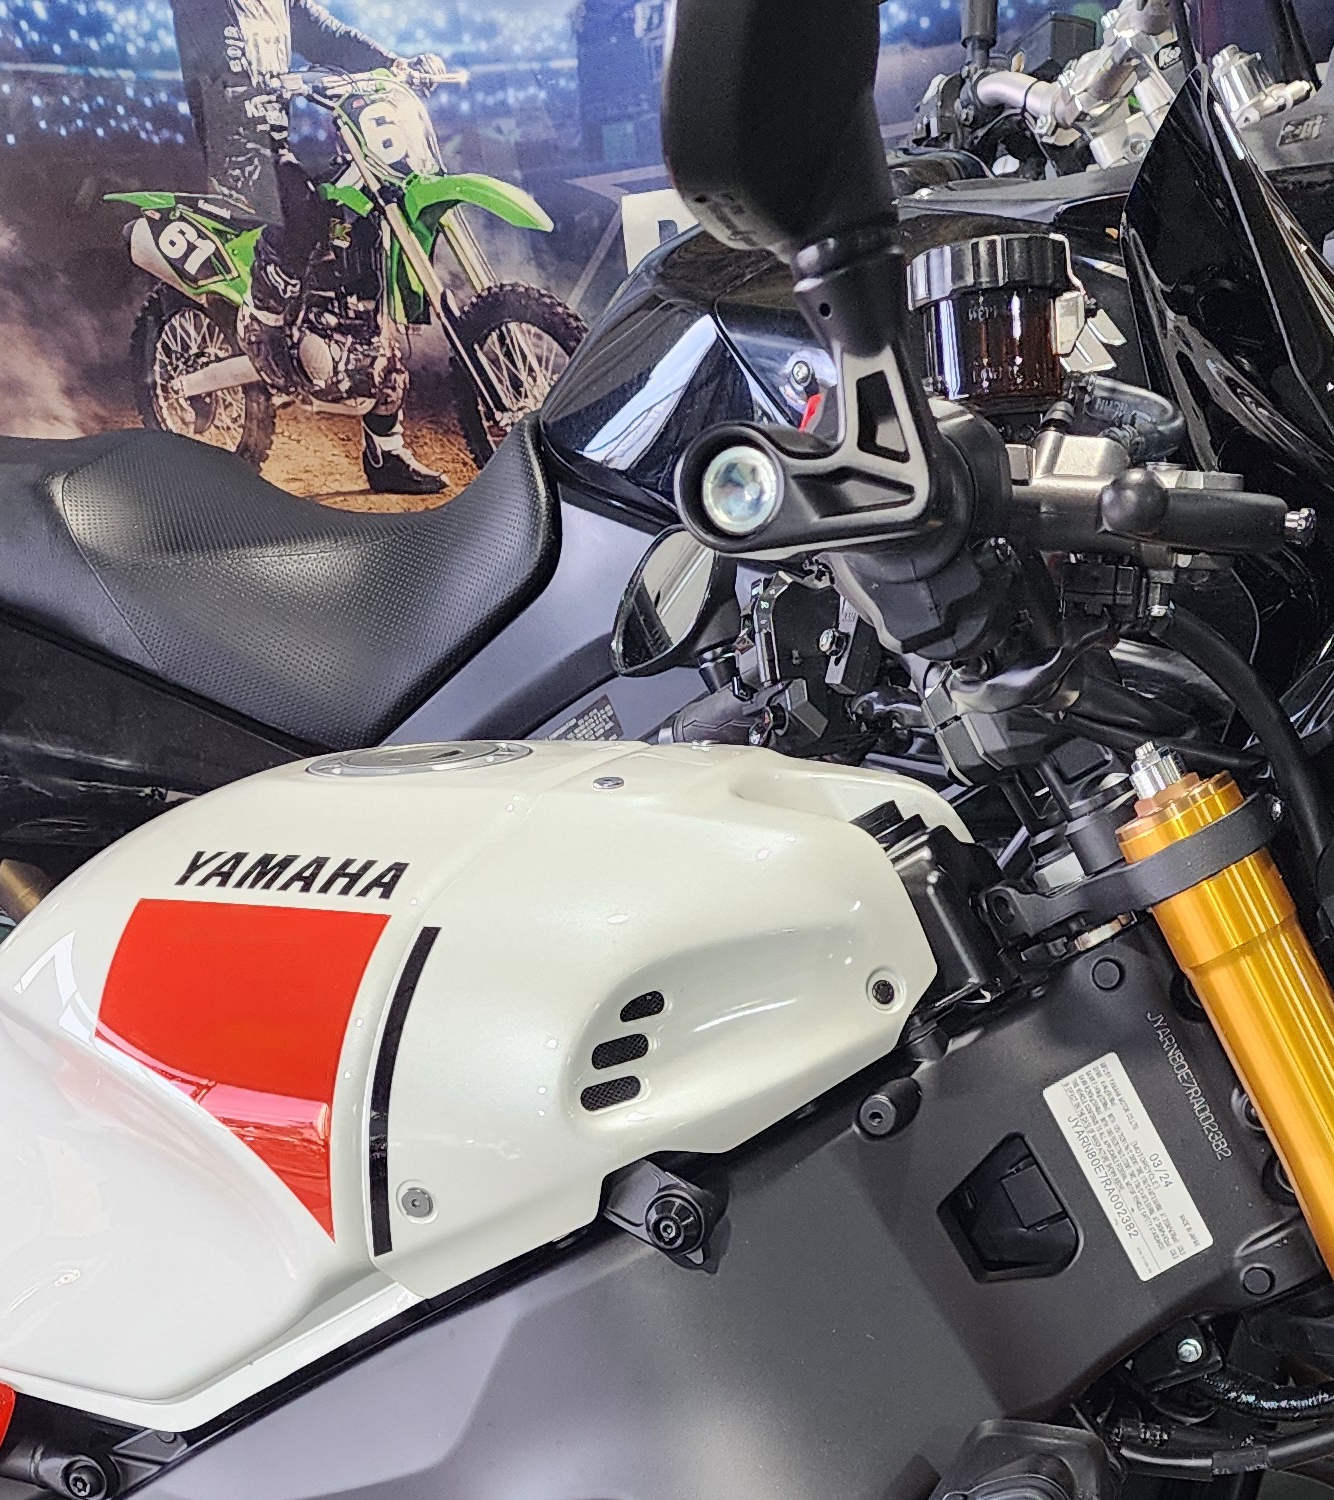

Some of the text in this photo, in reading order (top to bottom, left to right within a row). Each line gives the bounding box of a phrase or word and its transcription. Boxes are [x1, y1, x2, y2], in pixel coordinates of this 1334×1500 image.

[159, 221, 216, 275] 61
[173, 850, 411, 900] YAMAHA
[1066, 1112, 1140, 1240] JYARN80E7RA002382
[1147, 1151, 1174, 1189] 03/24
